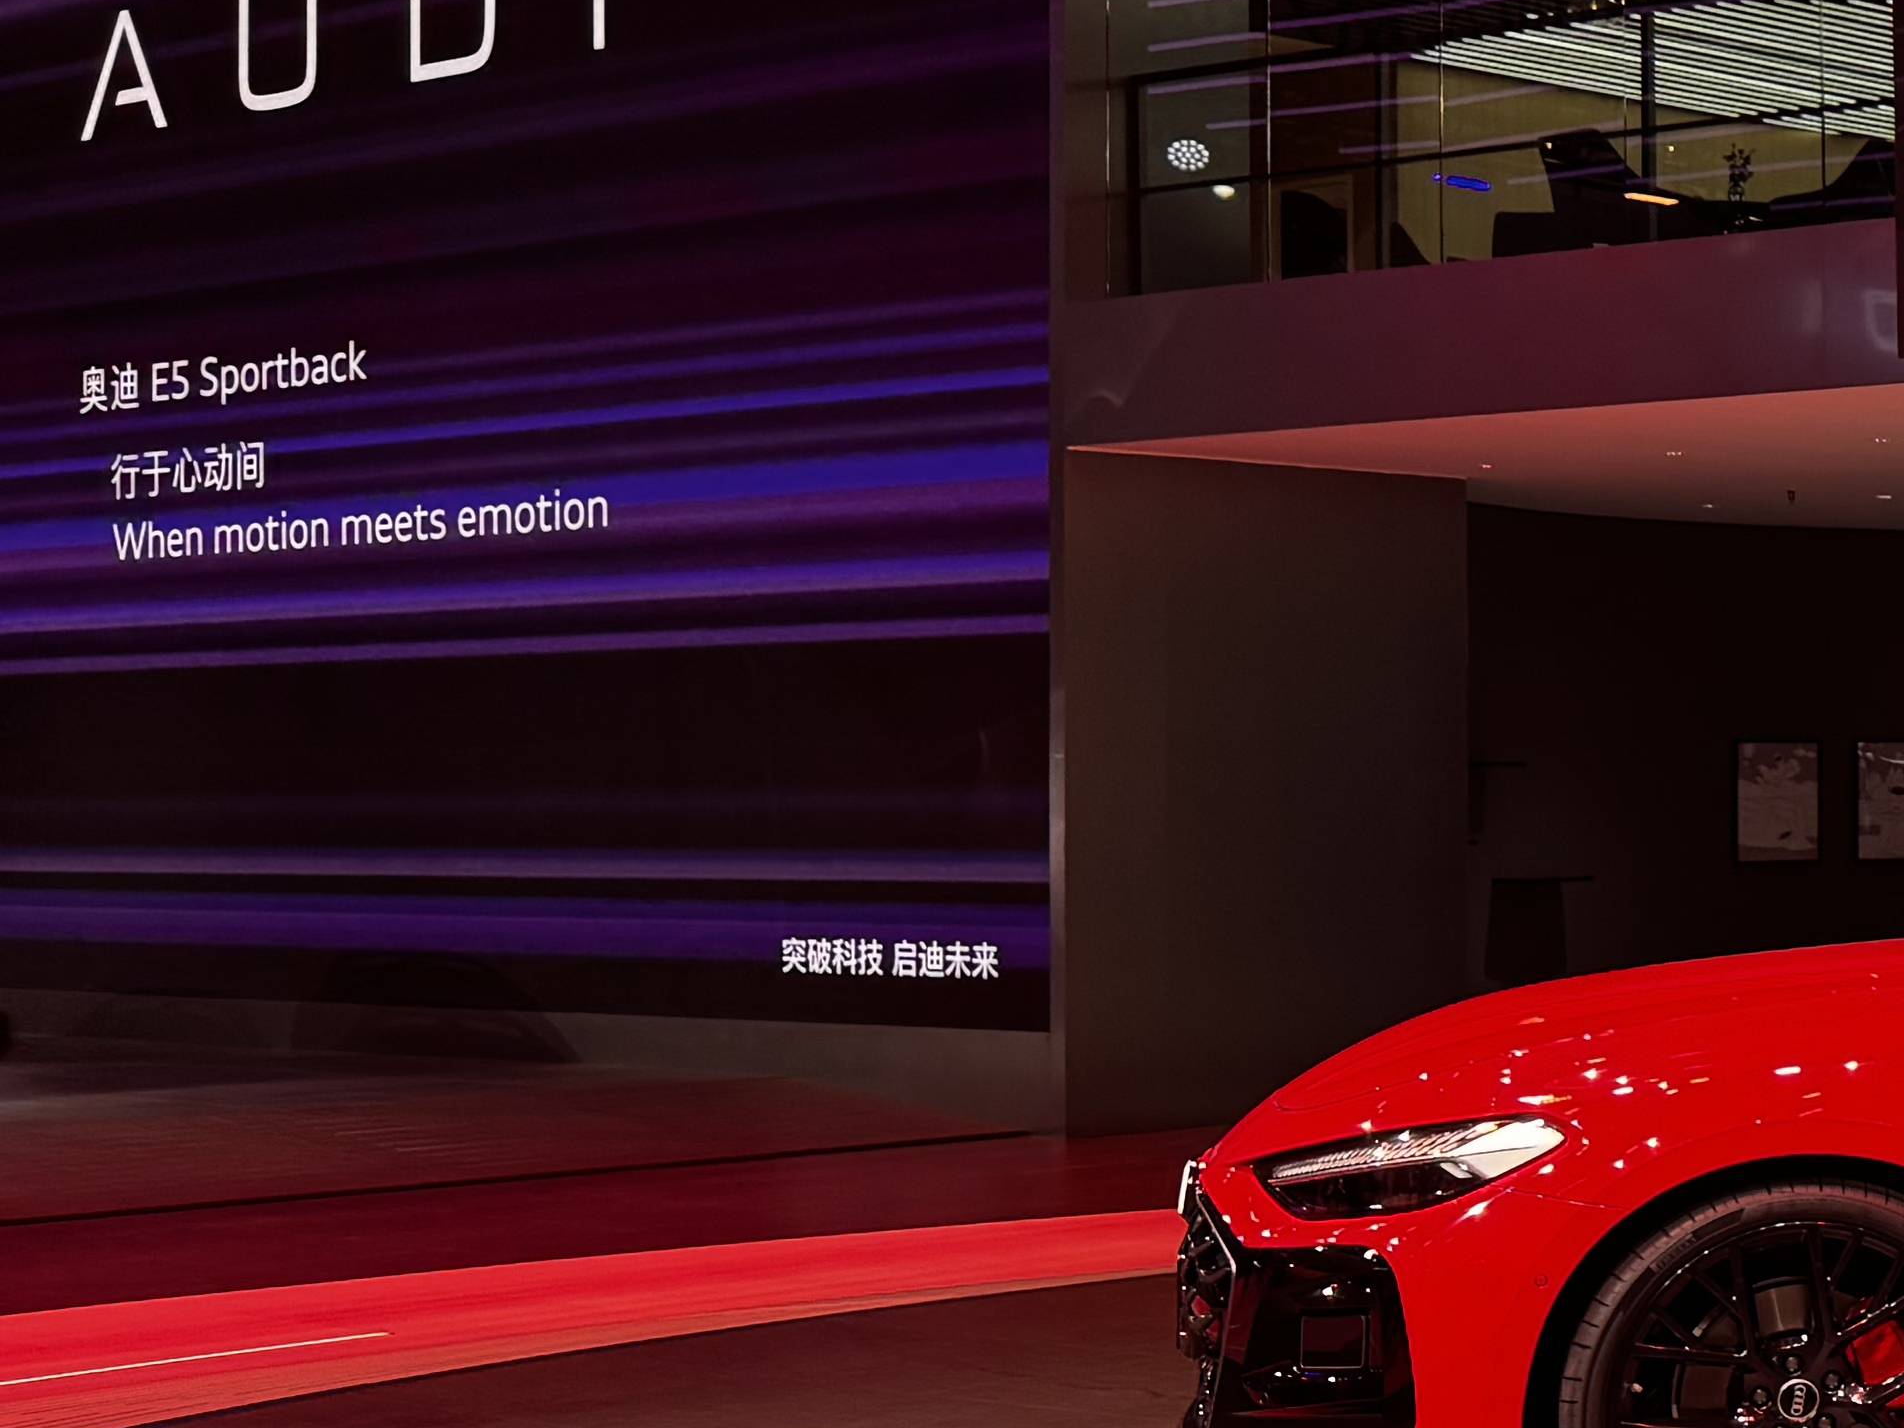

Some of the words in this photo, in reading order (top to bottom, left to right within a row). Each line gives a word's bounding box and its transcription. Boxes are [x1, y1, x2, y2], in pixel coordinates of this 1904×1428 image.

[78, 361, 141, 416] 奥迪
[150, 358, 191, 403] E5
[198, 339, 368, 407] Sportback
[109, 440, 266, 502] 行于心动间
[111, 519, 204, 561] When
[213, 509, 330, 556] motion
[340, 503, 448, 547] meets
[456, 487, 609, 539] emotion
[780, 935, 884, 976] 突破科技
[890, 938, 1000, 980] 启迪未来
